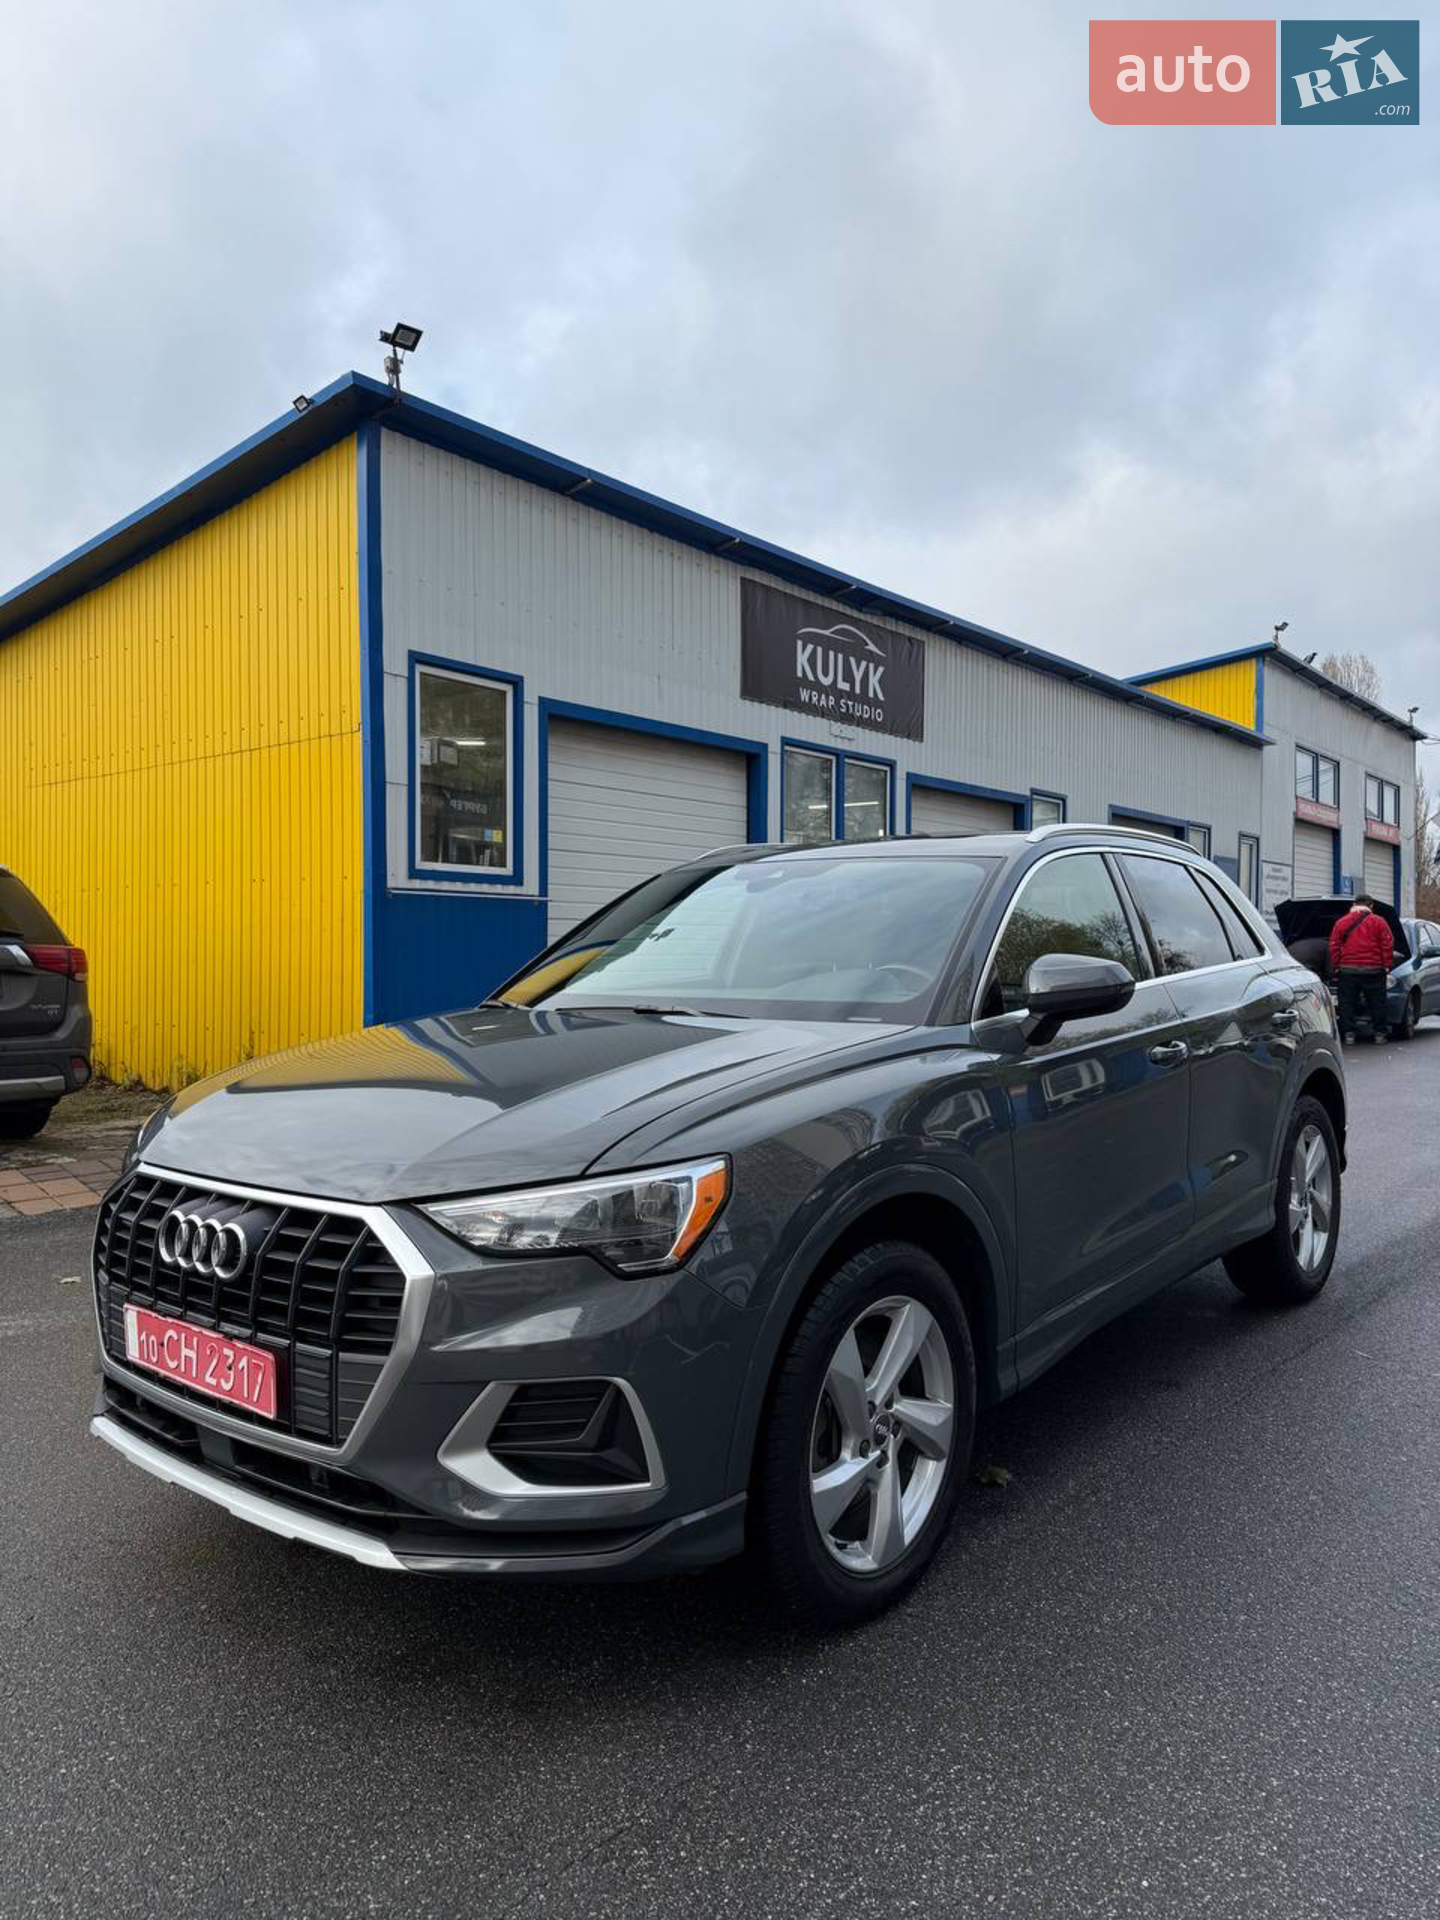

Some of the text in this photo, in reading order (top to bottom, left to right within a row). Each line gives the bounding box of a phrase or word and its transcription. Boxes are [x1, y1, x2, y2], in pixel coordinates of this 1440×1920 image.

[796, 639, 885, 701] KULYK
[800, 688, 884, 722] WRAP STUDIO
[140, 1329, 265, 1403] 10 CH 2317
